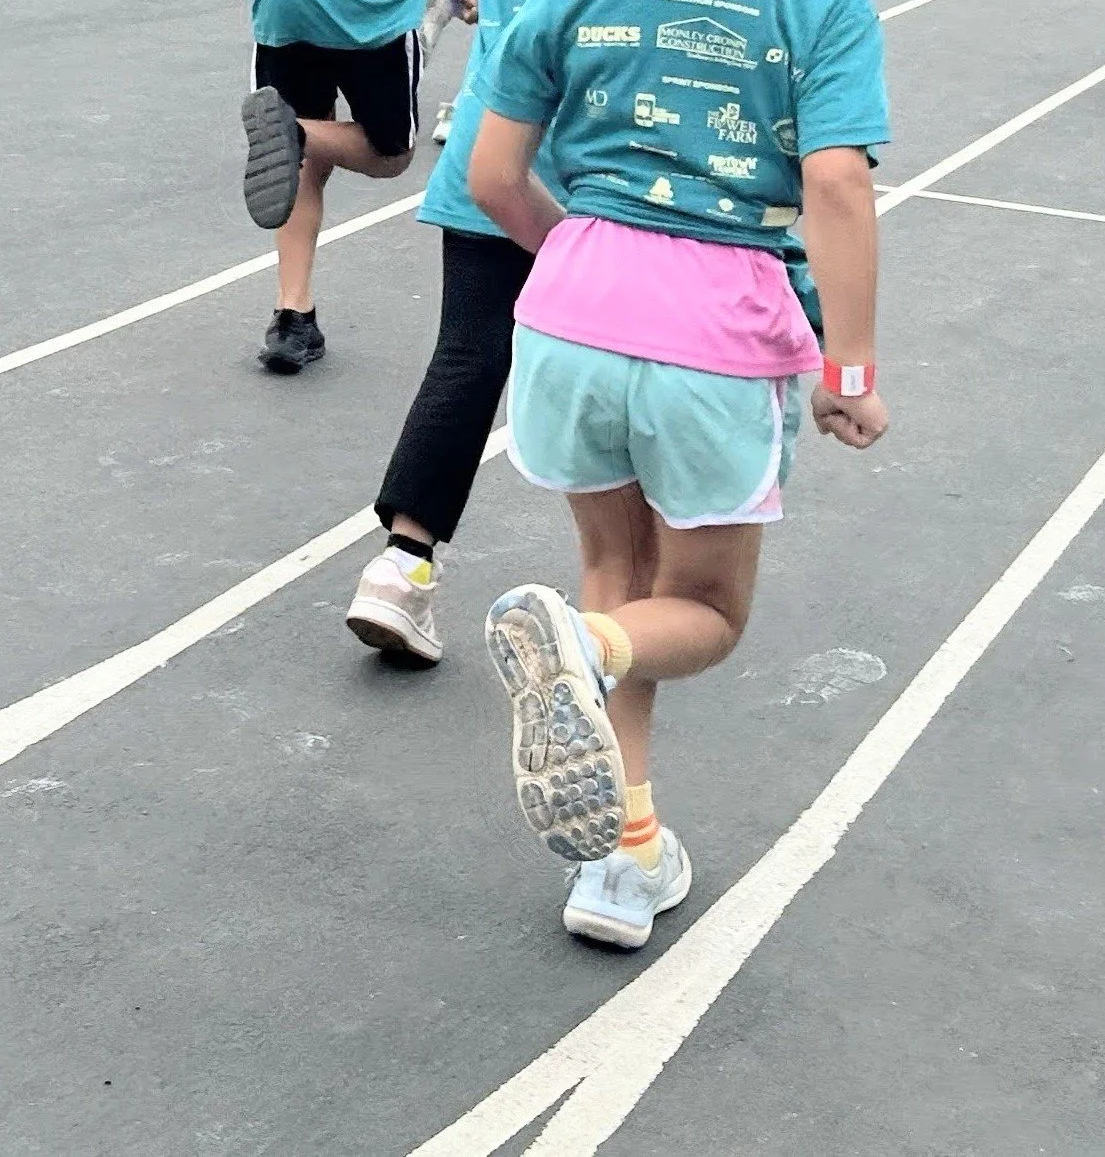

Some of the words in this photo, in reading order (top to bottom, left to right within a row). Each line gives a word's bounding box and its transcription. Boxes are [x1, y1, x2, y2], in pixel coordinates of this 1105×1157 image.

[577, 26, 641, 43] DUCKS
[659, 37, 745, 59] CONSTRUCTION
[718, 128, 758, 144] FARM
